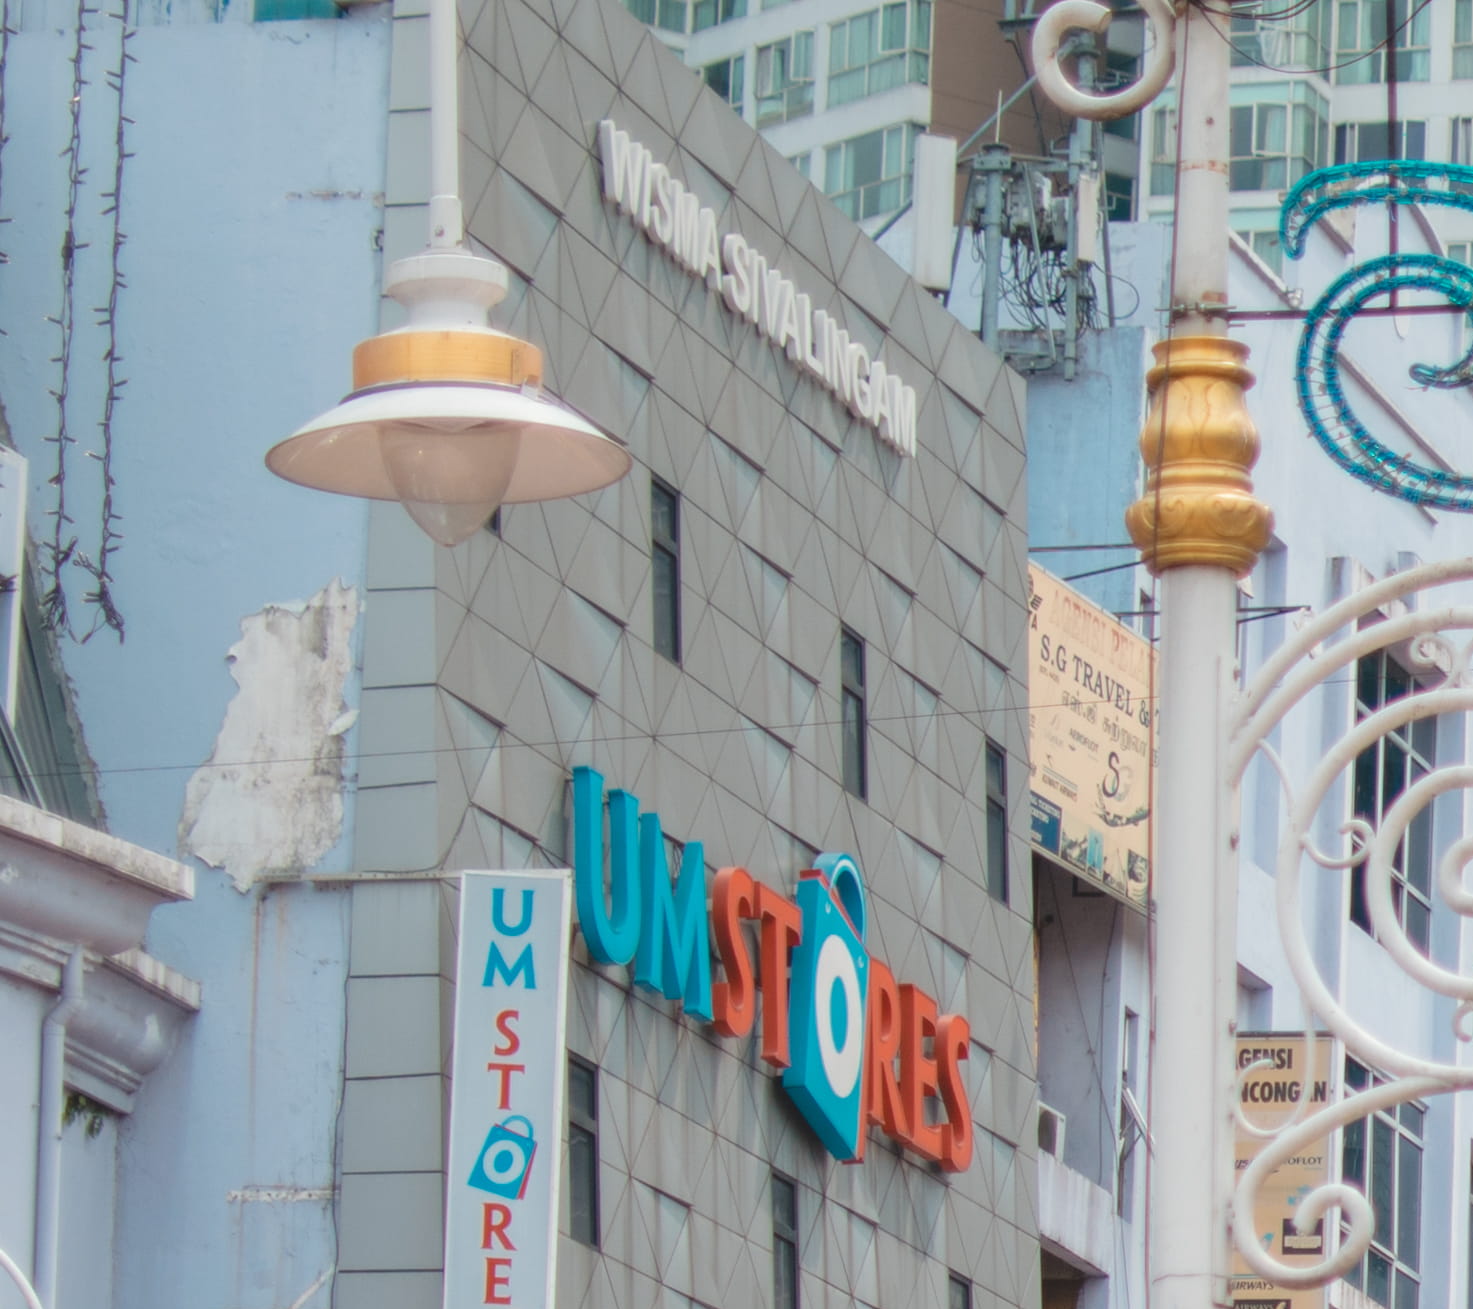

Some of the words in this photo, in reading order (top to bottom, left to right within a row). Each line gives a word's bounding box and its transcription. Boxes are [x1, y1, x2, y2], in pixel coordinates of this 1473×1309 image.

[600, 119, 722, 292] WISMA
[722, 232, 917, 458] SIVALINGAM
[1040, 634, 1067, 674] S.G
[1073, 653, 1134, 717] TRAVEL
[1139, 699, 1150, 729] &
[1236, 1048, 1293, 1071] GENSI
